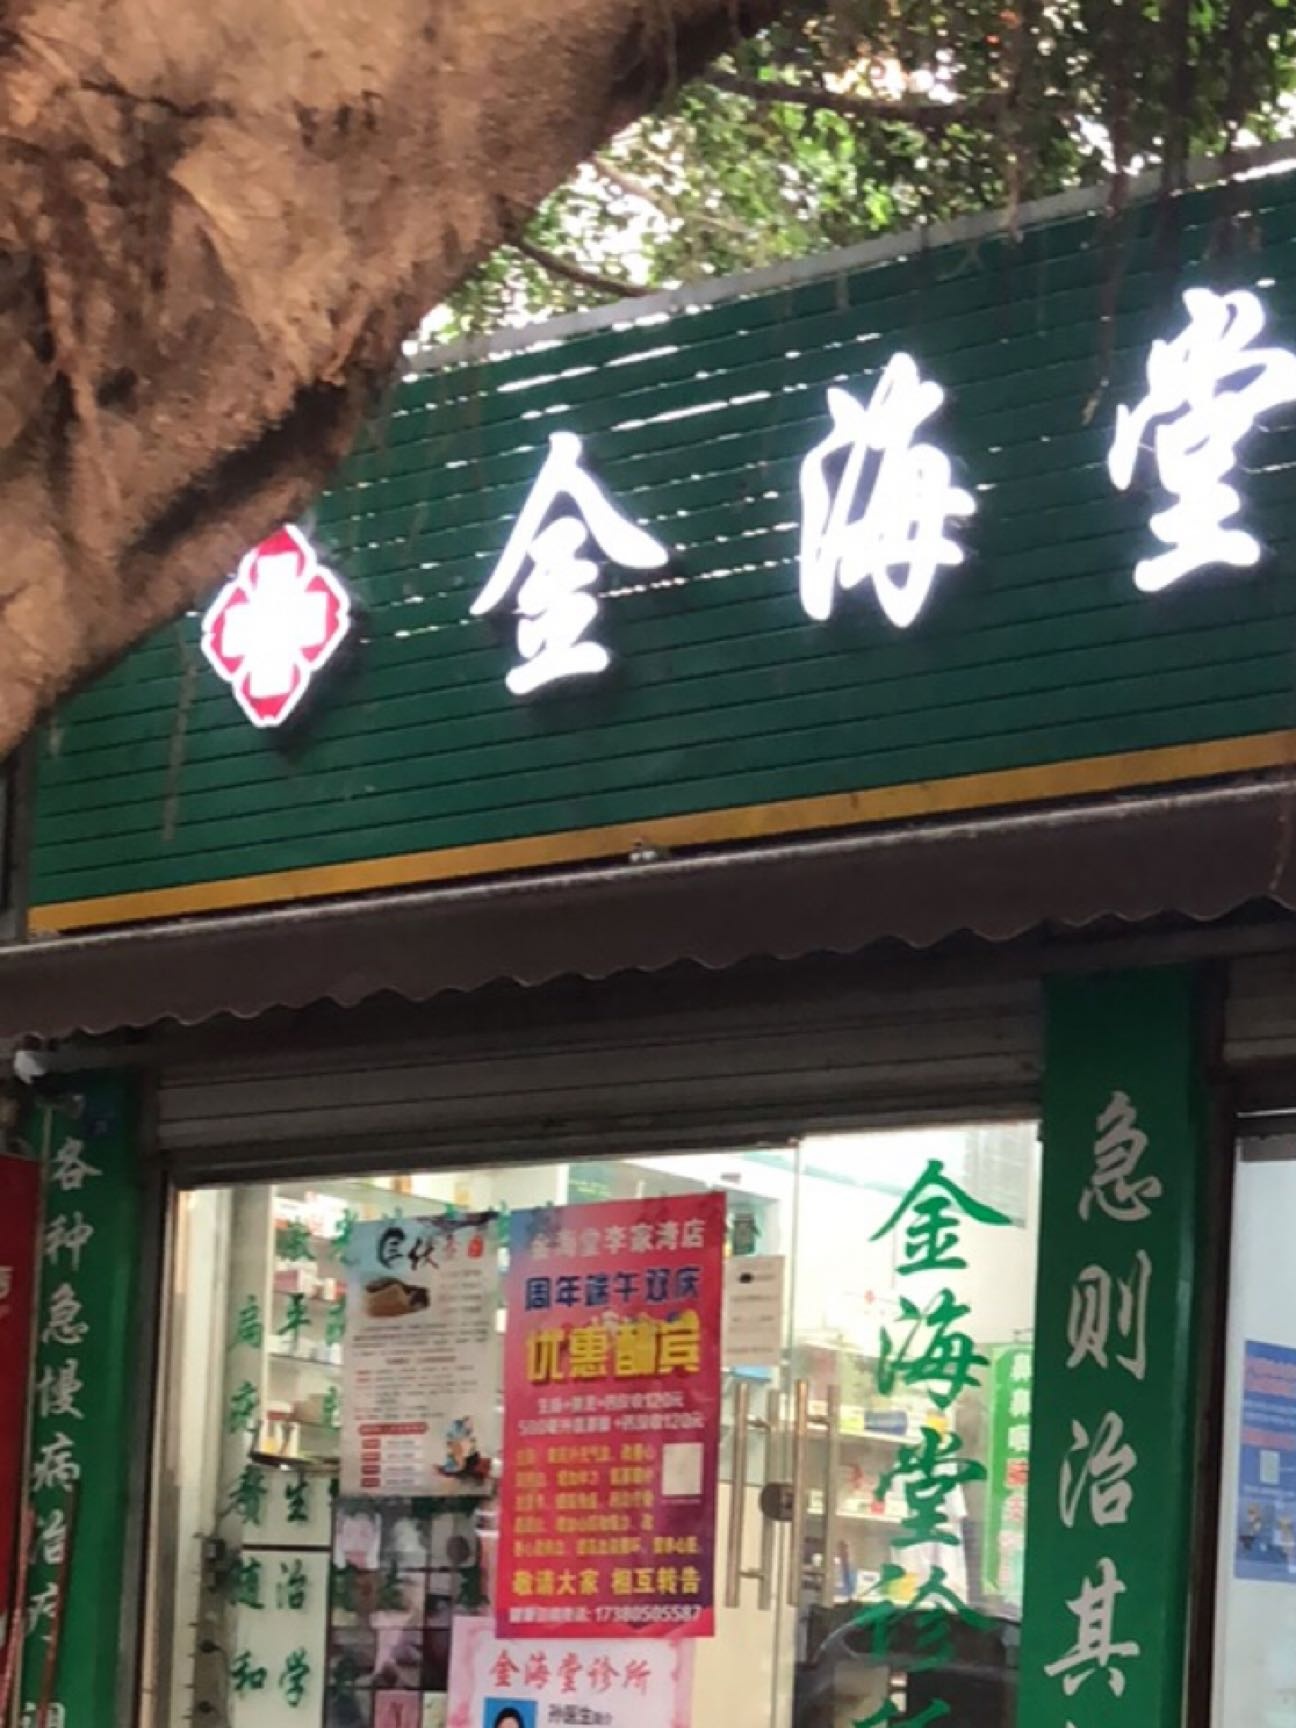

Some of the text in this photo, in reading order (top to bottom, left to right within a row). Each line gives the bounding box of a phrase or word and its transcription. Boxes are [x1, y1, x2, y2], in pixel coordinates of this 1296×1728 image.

[489, 1648, 651, 1696] 金海堂诊所
